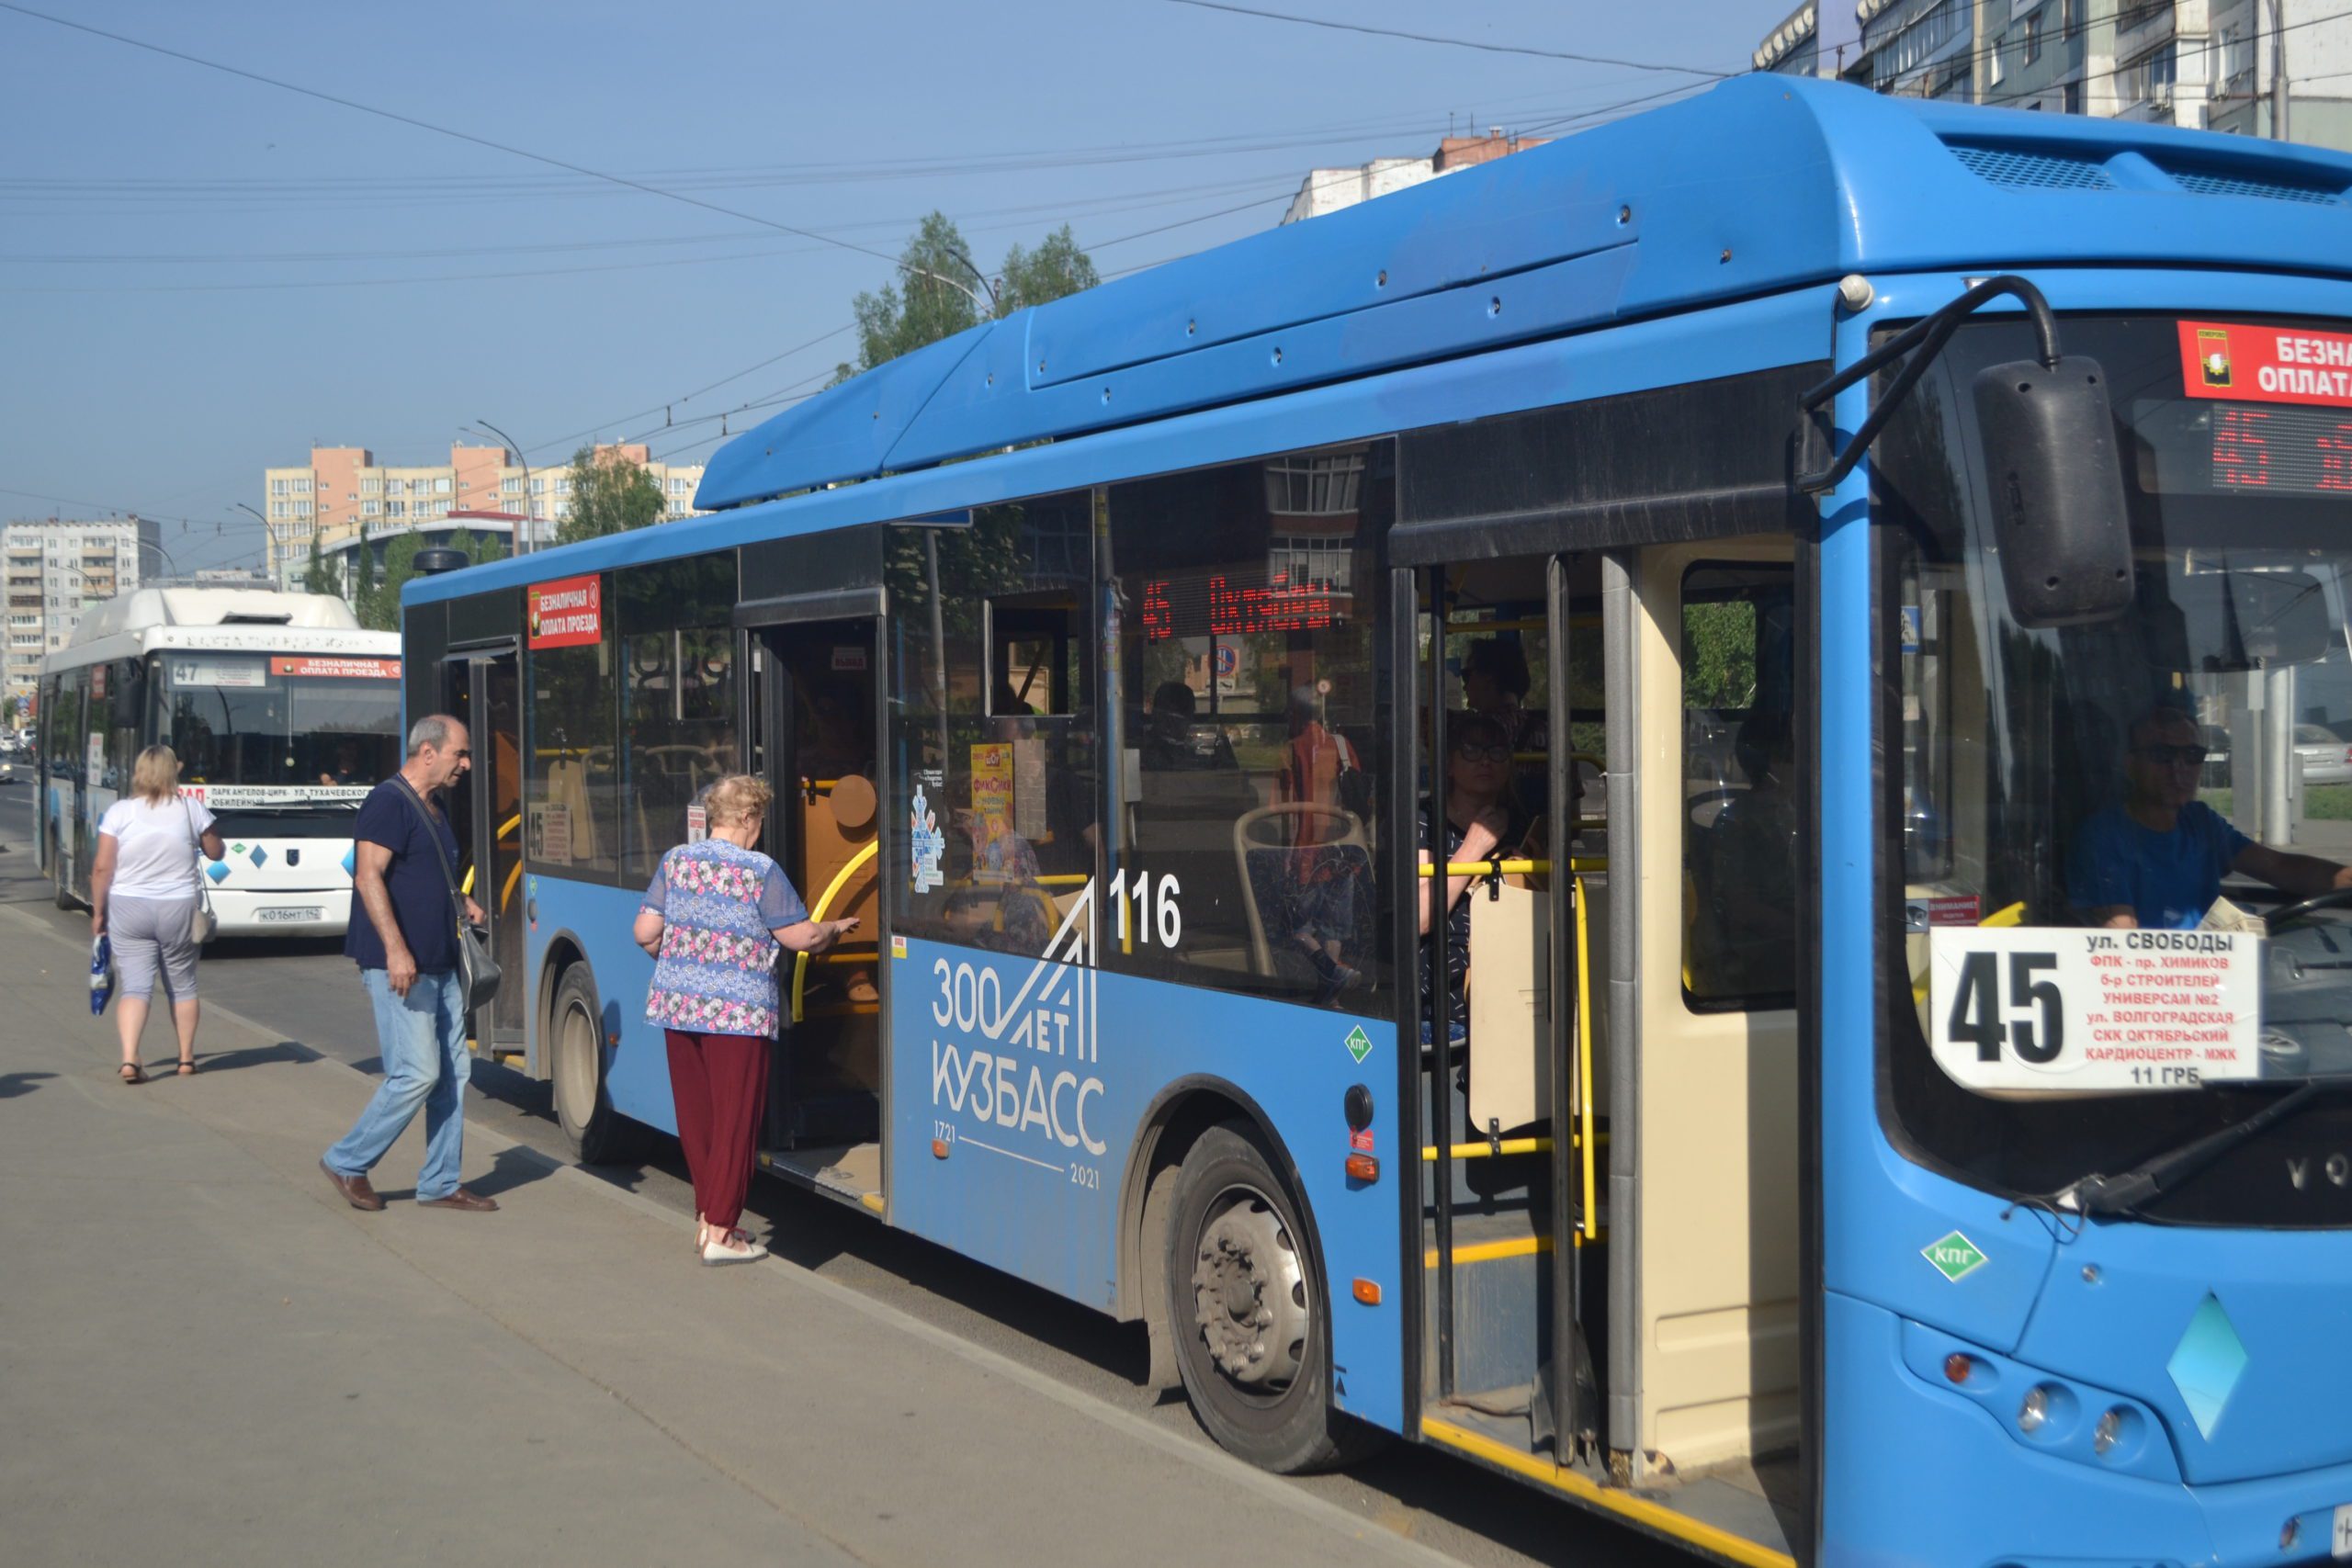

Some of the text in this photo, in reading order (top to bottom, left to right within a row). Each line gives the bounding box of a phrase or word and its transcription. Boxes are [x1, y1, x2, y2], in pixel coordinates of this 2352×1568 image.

[2276, 336, 2352, 367] БЕЗН
[2257, 366, 2352, 397] ОПЛАТ
[2212, 412, 2269, 485] 45
[540, 589, 588, 612] БЕЗНАЛИЧНАЯ
[1143, 581, 1171, 638] 45
[540, 613, 598, 636] ОПЛАТА ПРОЕЗДА
[175, 662, 199, 682] 47
[300, 666, 387, 678] ОПЛАТА ПРОЕЗДА
[308, 659, 379, 669] БЕЗНАЛИЧНАЯ
[529, 812, 544, 857] 45
[1110, 868, 1182, 949] 116
[2086, 932, 2233, 953] ул. СВОБОДЫ
[2090, 956, 2123, 968] ФПК
[2134, 957, 2156, 970] пр.
[2160, 956, 2230, 969] ХИМИКОВ
[2100, 973, 2221, 987] б-р СТРОИТЕЛЕЙ
[933, 958, 1001, 1041] 300
[1948, 951, 2064, 1064] 45
[2102, 992, 2219, 1006] УНИВЕРСАМ №2
[2086, 1011, 2233, 1025] ул. ВОЛГОГРАДСКАЯ
[1349, 1037, 1366, 1051] КПГ
[2093, 1029, 2230, 1043] СКК ОКТЯБРЬСКИЙ
[2086, 1047, 2194, 1062] КАРДИОЦЕНТР
[2205, 1048, 2237, 1061] МЖК
[2130, 1066, 2154, 1084] 11
[933, 1040, 1107, 1156] КУЗБАСС
[933, 1120, 1101, 1191] 1721 2021
[1934, 1247, 1975, 1265] КПГ
